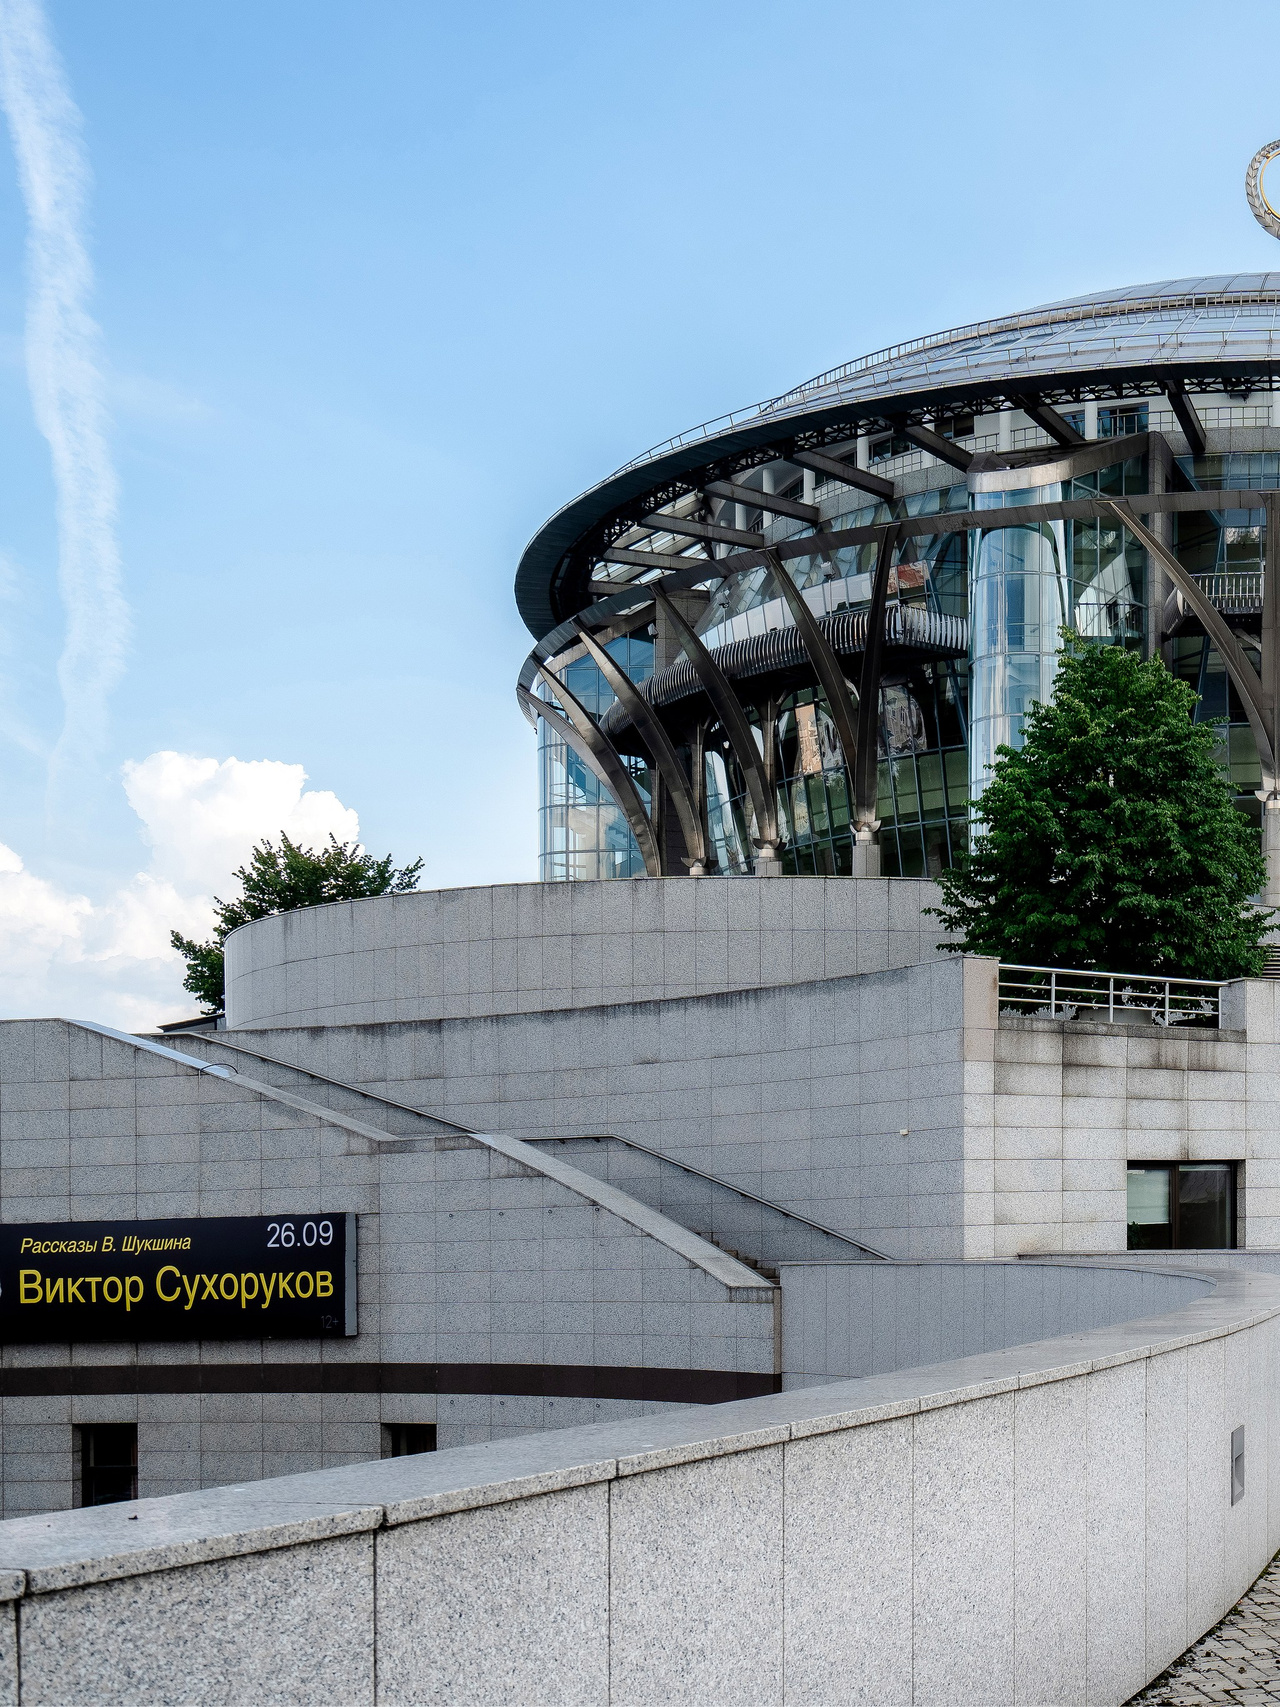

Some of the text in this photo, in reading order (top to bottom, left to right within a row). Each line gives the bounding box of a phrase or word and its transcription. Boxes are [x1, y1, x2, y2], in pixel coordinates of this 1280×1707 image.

[20, 1235, 192, 1256] Рассказы В. Шукшина
[266, 1220, 334, 1248] 26.09
[19, 1265, 334, 1312] Виктор Сухоруков
[320, 1314, 339, 1330] 12+
